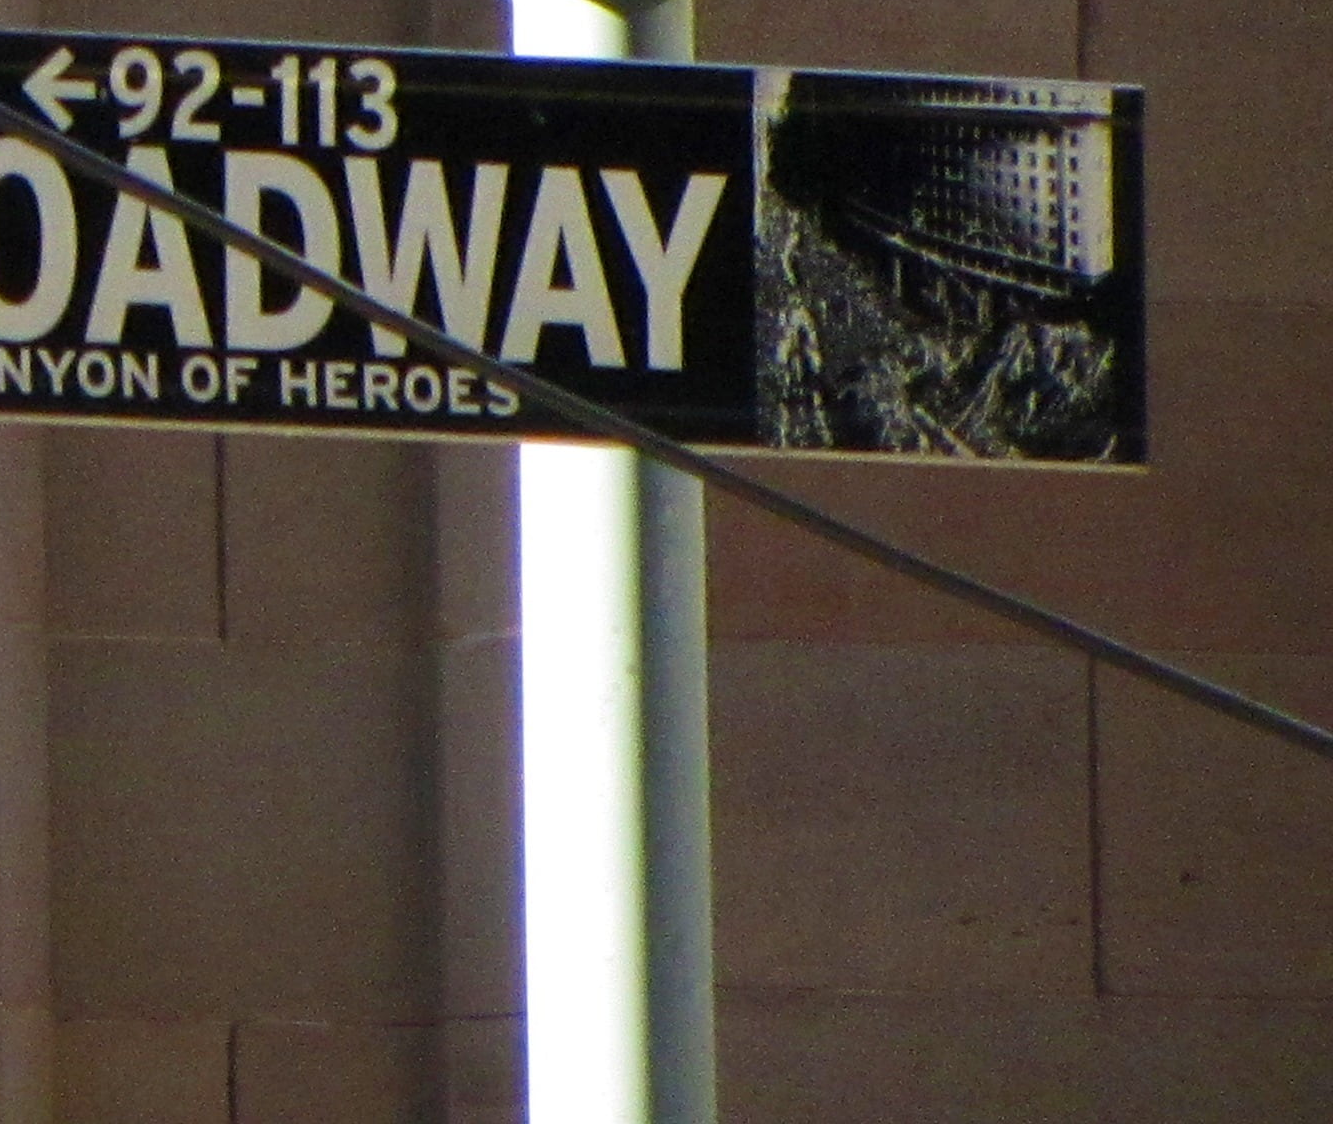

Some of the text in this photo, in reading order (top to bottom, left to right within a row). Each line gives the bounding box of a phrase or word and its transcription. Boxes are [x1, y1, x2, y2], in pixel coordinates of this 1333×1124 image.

[108, 45, 399, 152] 92-113
[180, 353, 259, 404] OF
[280, 360, 521, 417] HEROES
